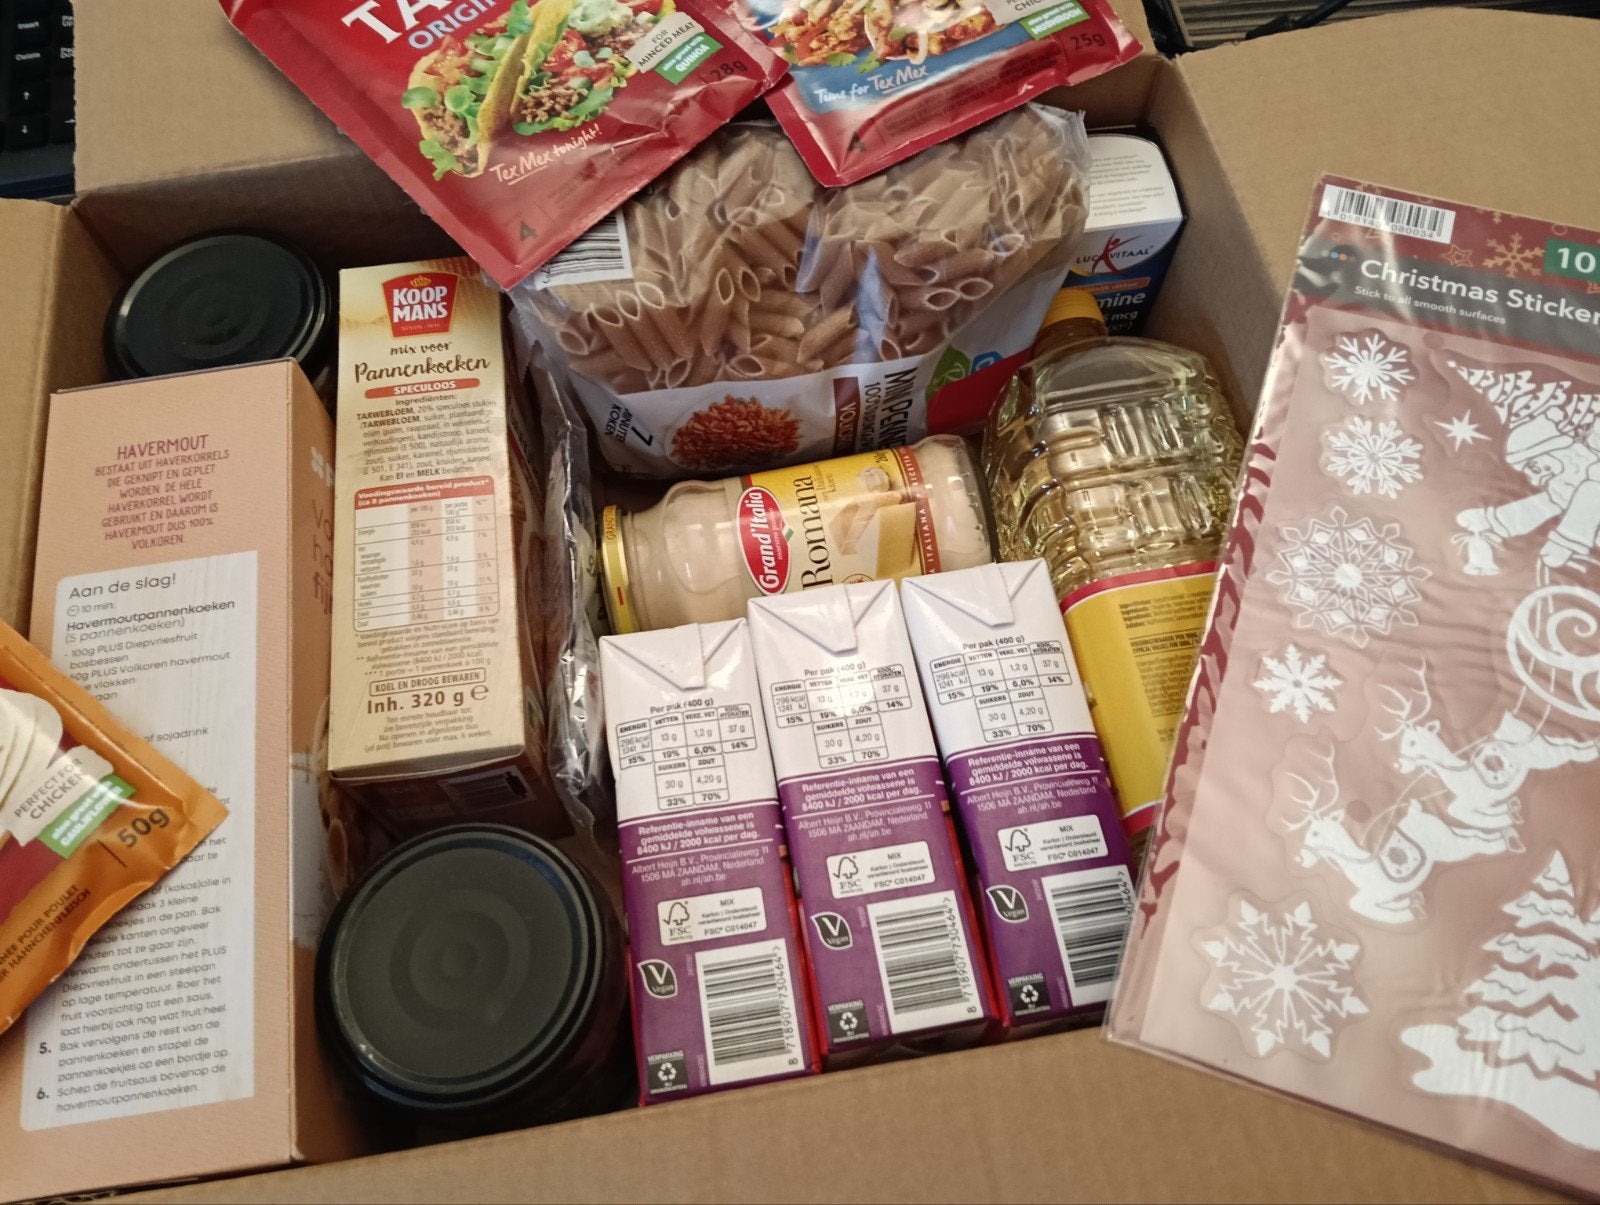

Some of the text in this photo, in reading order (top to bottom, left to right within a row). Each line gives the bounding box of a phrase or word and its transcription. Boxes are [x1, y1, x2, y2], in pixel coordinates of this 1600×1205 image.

[342, 0, 453, 44] TA
[408, 0, 497, 50] ORIGI
[1031, 8, 1081, 35] MUSHROOM
[638, 21, 696, 67] MINCED MEAT
[651, 29, 669, 44] FOR
[1073, 33, 1106, 51] 25g
[675, 44, 711, 73] QUINOA
[712, 61, 749, 81] 28g
[814, 64, 930, 104] Time for Tex Mex
[488, 122, 602, 184] Tex Mex tonight!
[1557, 247, 1597, 274] 10
[392, 285, 449, 307] KOOP
[1354, 284, 1507, 325] Stick to all smooth surfaces
[1360, 259, 1600, 325] Christmas Sticker
[392, 302, 449, 324] MANS
[389, 341, 453, 356] mix voor
[353, 354, 492, 383] Pannenkoeken
[393, 380, 457, 396] SPECULOOS
[603, 403, 620, 437] KOKEN
[117, 434, 209, 461] HAVERMOUT
[630, 425, 653, 446] 7
[95, 449, 230, 477] BESTAAT UIT HAVERKORRELS
[107, 464, 216, 488] DIE GEKNIPT EN GEPLET
[164, 482, 177, 493] DE
[179, 479, 202, 490] HELE
[108, 489, 214, 514] HAVERKORREL WORDT
[101, 502, 219, 528] GEBRUIKT EN DAAROM IS
[104, 517, 214, 540] HAVERMOUT DUS 100%
[744, 490, 782, 589] Grand'Italia
[792, 475, 834, 590] Romana
[919, 507, 934, 562] ITALIANA
[69, 572, 177, 601] Aan de slag!
[66, 599, 236, 632] Havermoutpannenkoeken
[82, 604, 93, 613] 10
[65, 618, 185, 645] (5 pannenkoeken)
[963, 635, 1026, 651] Per pak (400 g)
[71, 631, 199, 659] 100g PLUS Diepvriesfruit
[69, 653, 129, 670] bosbessen
[91, 650, 231, 679] PLUS Volkoren havermout
[933, 652, 993, 669] ENERGIE VETTEN
[93, 676, 136, 690] vlakken
[375, 671, 481, 694] KOEL EN DROOG BEWAREN
[947, 690, 966, 700] 15%
[981, 675, 1064, 693] 19% 6,0% 14%
[366, 690, 465, 715] Inh. 320 g
[978, 690, 1035, 705] SUIKERS ZOUT
[988, 706, 1036, 721] 30 4,20
[156, 726, 209, 743] sojadrink
[991, 723, 1046, 738] 33% 70%
[967, 743, 1081, 767] Referentie-inname van een
[971, 751, 1083, 777] gemiddelde volwassene is
[968, 760, 1089, 787] 8400 kJ 2000 kcal per dag.
[13, 757, 84, 819] PERFECT FOR
[116, 805, 171, 849] 50g
[638, 817, 719, 836] Referentie-inname
[887, 852, 903, 861] MIX
[1068, 847, 1099, 859] C014047
[43, 884, 79, 918] POULET
[669, 925, 692, 937] FSC
[724, 920, 758, 934] C014047
[39, 1025, 181, 1054] 5. Bak vervolgens de rest
[36, 1065, 209, 1100] 6. Schep de fruitsaus bovenop
